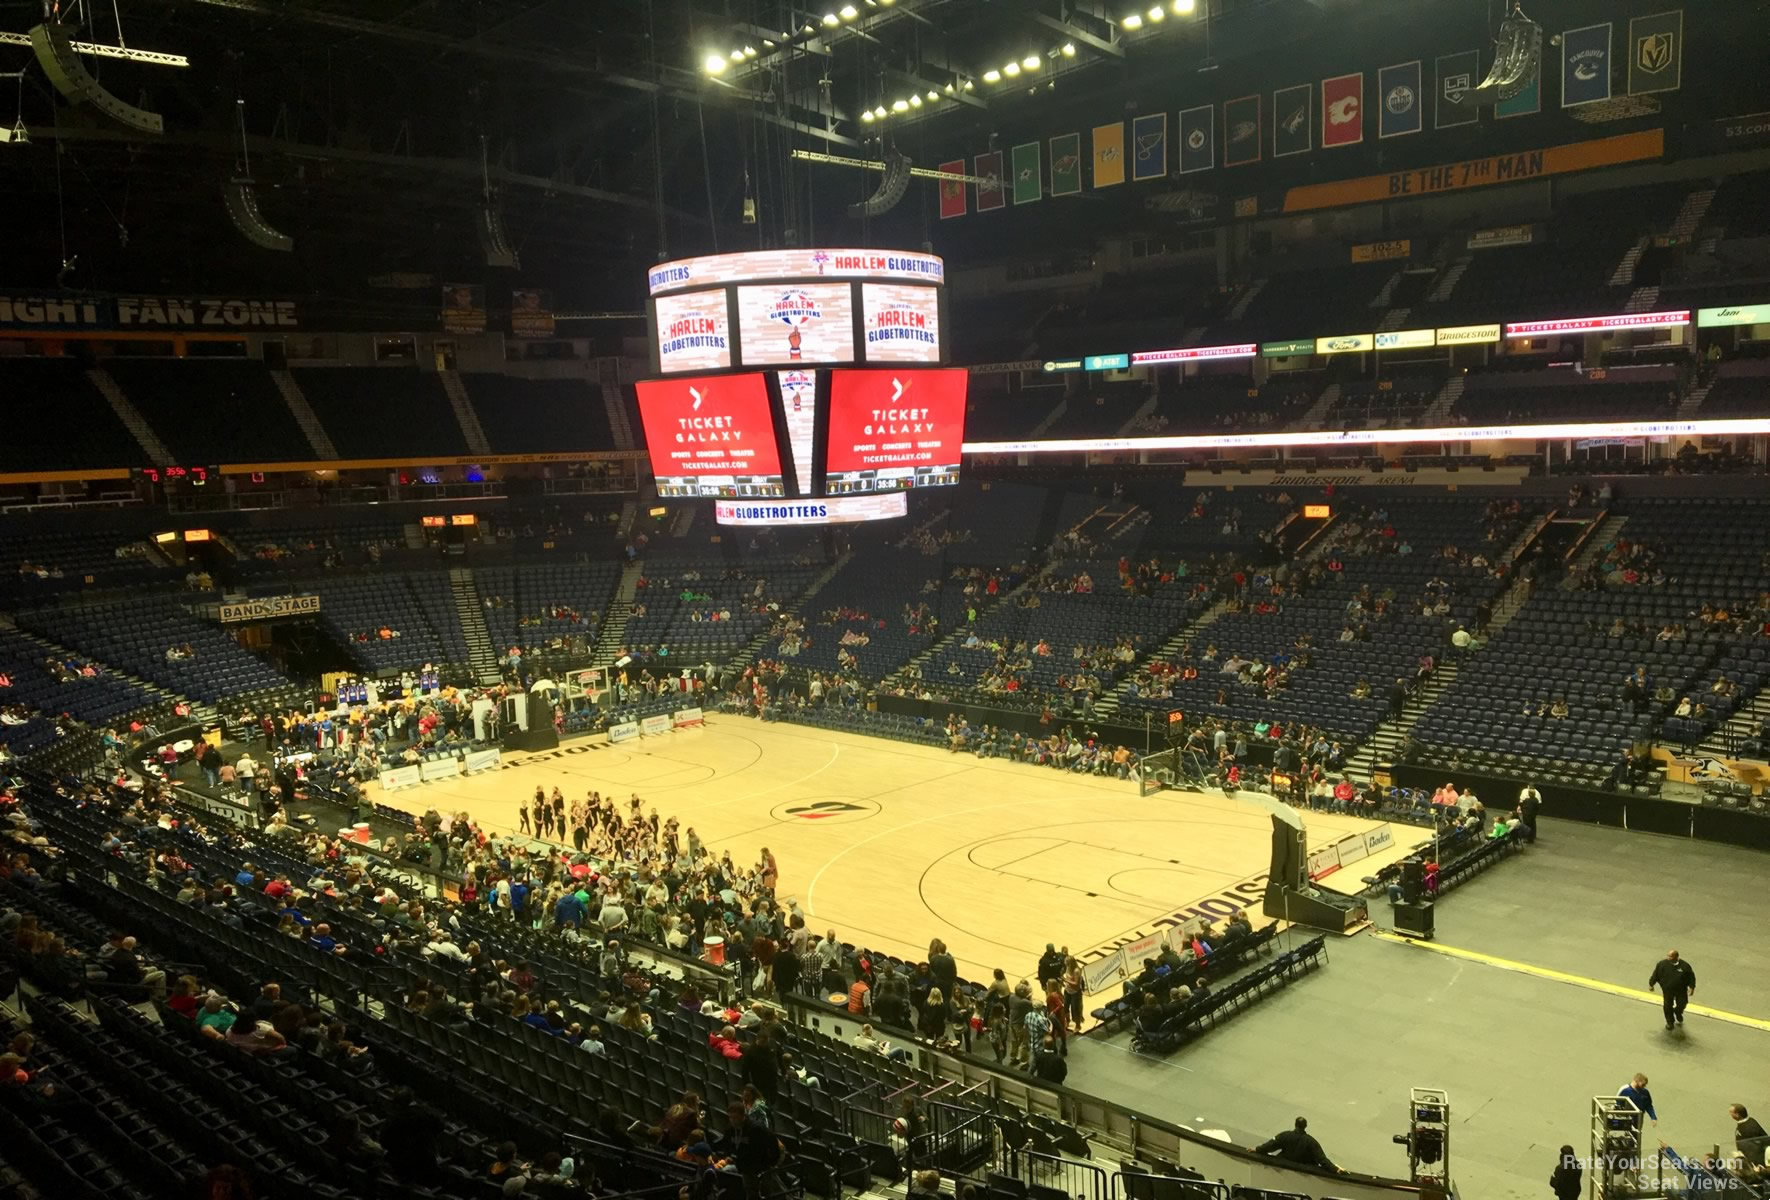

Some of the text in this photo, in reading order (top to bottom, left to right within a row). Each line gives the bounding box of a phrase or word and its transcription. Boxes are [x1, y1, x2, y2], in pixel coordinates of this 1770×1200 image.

[1446, 77, 1467, 89] LA
[1389, 173, 1411, 194] BE
[1420, 166, 1454, 191] THE
[1497, 152, 1543, 179] MAN
[835, 256, 886, 269] HARLEM
[776, 300, 814, 310] HARLEM
[119, 299, 195, 324] FAN
[201, 301, 297, 325] ZONE
[770, 309, 821, 319] GLOBETROTTERS
[877, 310, 926, 328] HARLEM
[1602, 314, 1684, 326] TICKETGALAXY.COM
[670, 318, 715, 338] HARLEM
[868, 327, 936, 344] GLOBETROTTERS
[1439, 329, 1498, 341] BRIDGESTONE
[662, 335, 726, 355] GLOBETROTTERS
[1103, 358, 1121, 366] AT&T
[872, 408, 928, 422] TICKET
[678, 416, 732, 430] TICKET
[864, 423, 934, 436] GALAXY
[676, 431, 741, 443] GALAXY
[863, 453, 932, 464] TICKETGALAXY.COM
[682, 461, 748, 470] TICKETGALAXY.COM
[1270, 476, 1415, 485] BRIDGESTONE ARENA
[736, 505, 827, 518] GLOBETROTTERS
[223, 598, 318, 617] BAND STAGE
[1368, 833, 1390, 848] Baden
